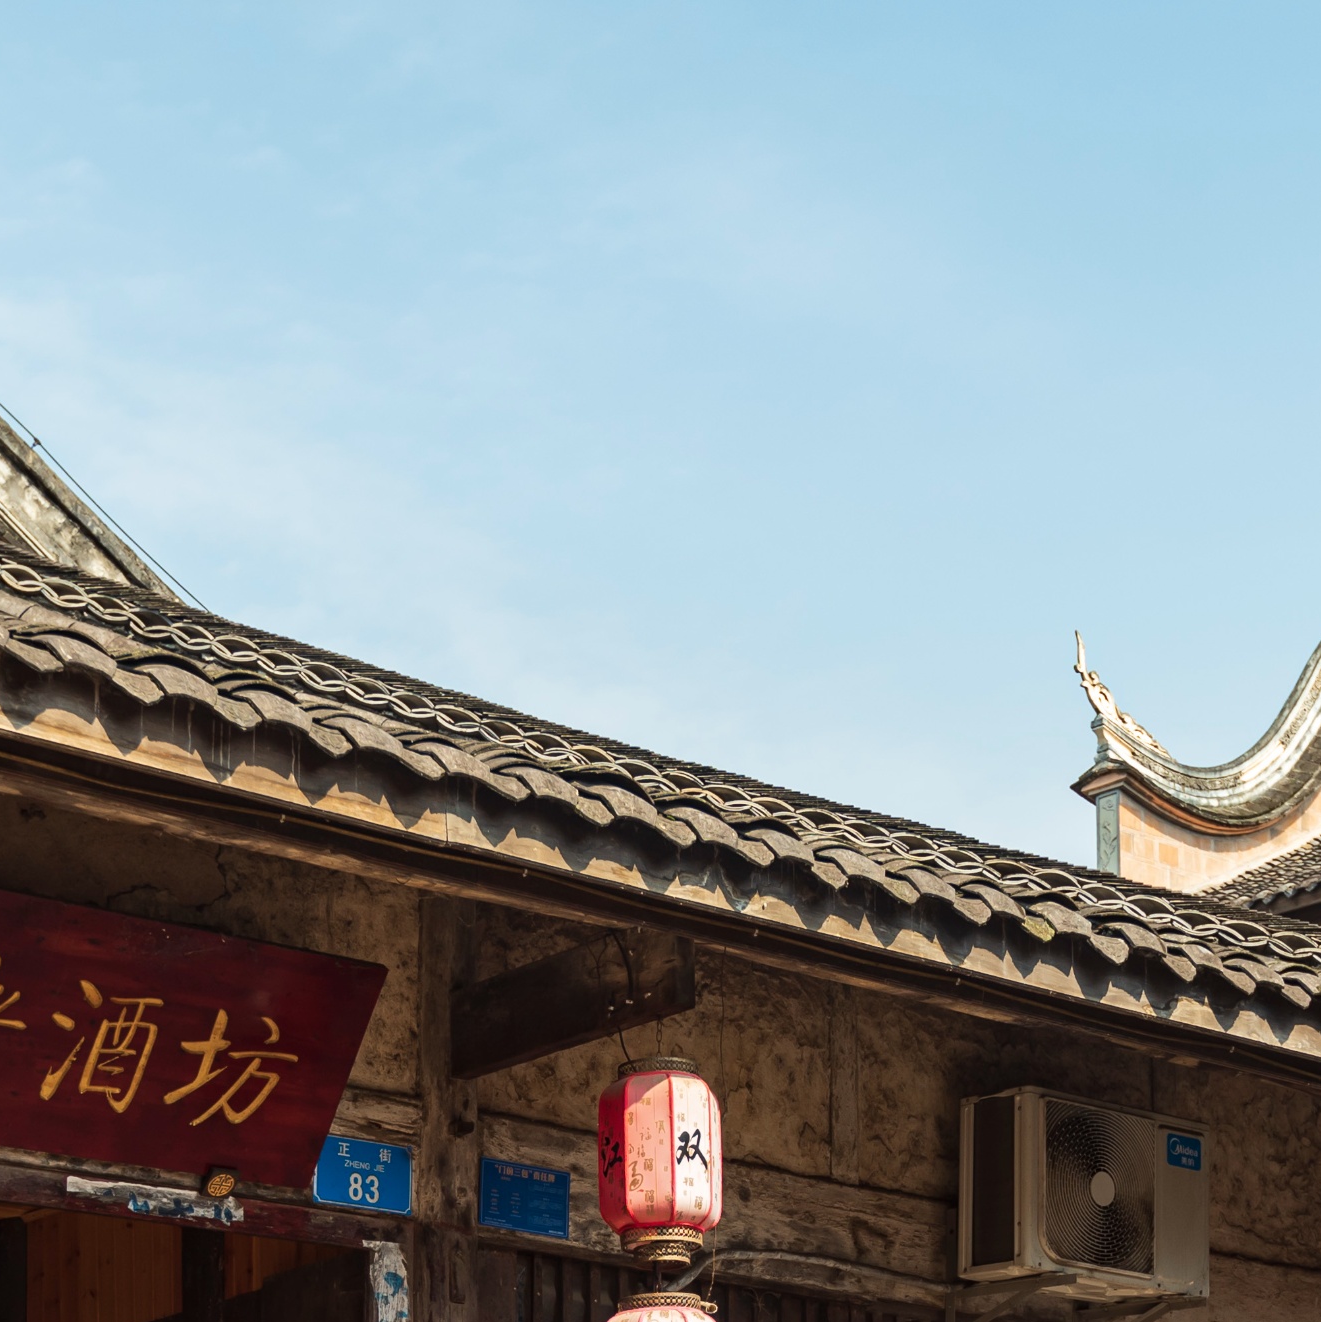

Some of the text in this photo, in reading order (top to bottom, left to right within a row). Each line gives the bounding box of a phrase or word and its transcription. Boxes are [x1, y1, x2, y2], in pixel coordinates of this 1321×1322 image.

[337, 1142, 392, 1163] 正街
[675, 1128, 708, 1170] 双
[1171, 1140, 1199, 1157] Midea
[344, 1159, 385, 1173] ZHENG JIE
[348, 1172, 380, 1204] 83
